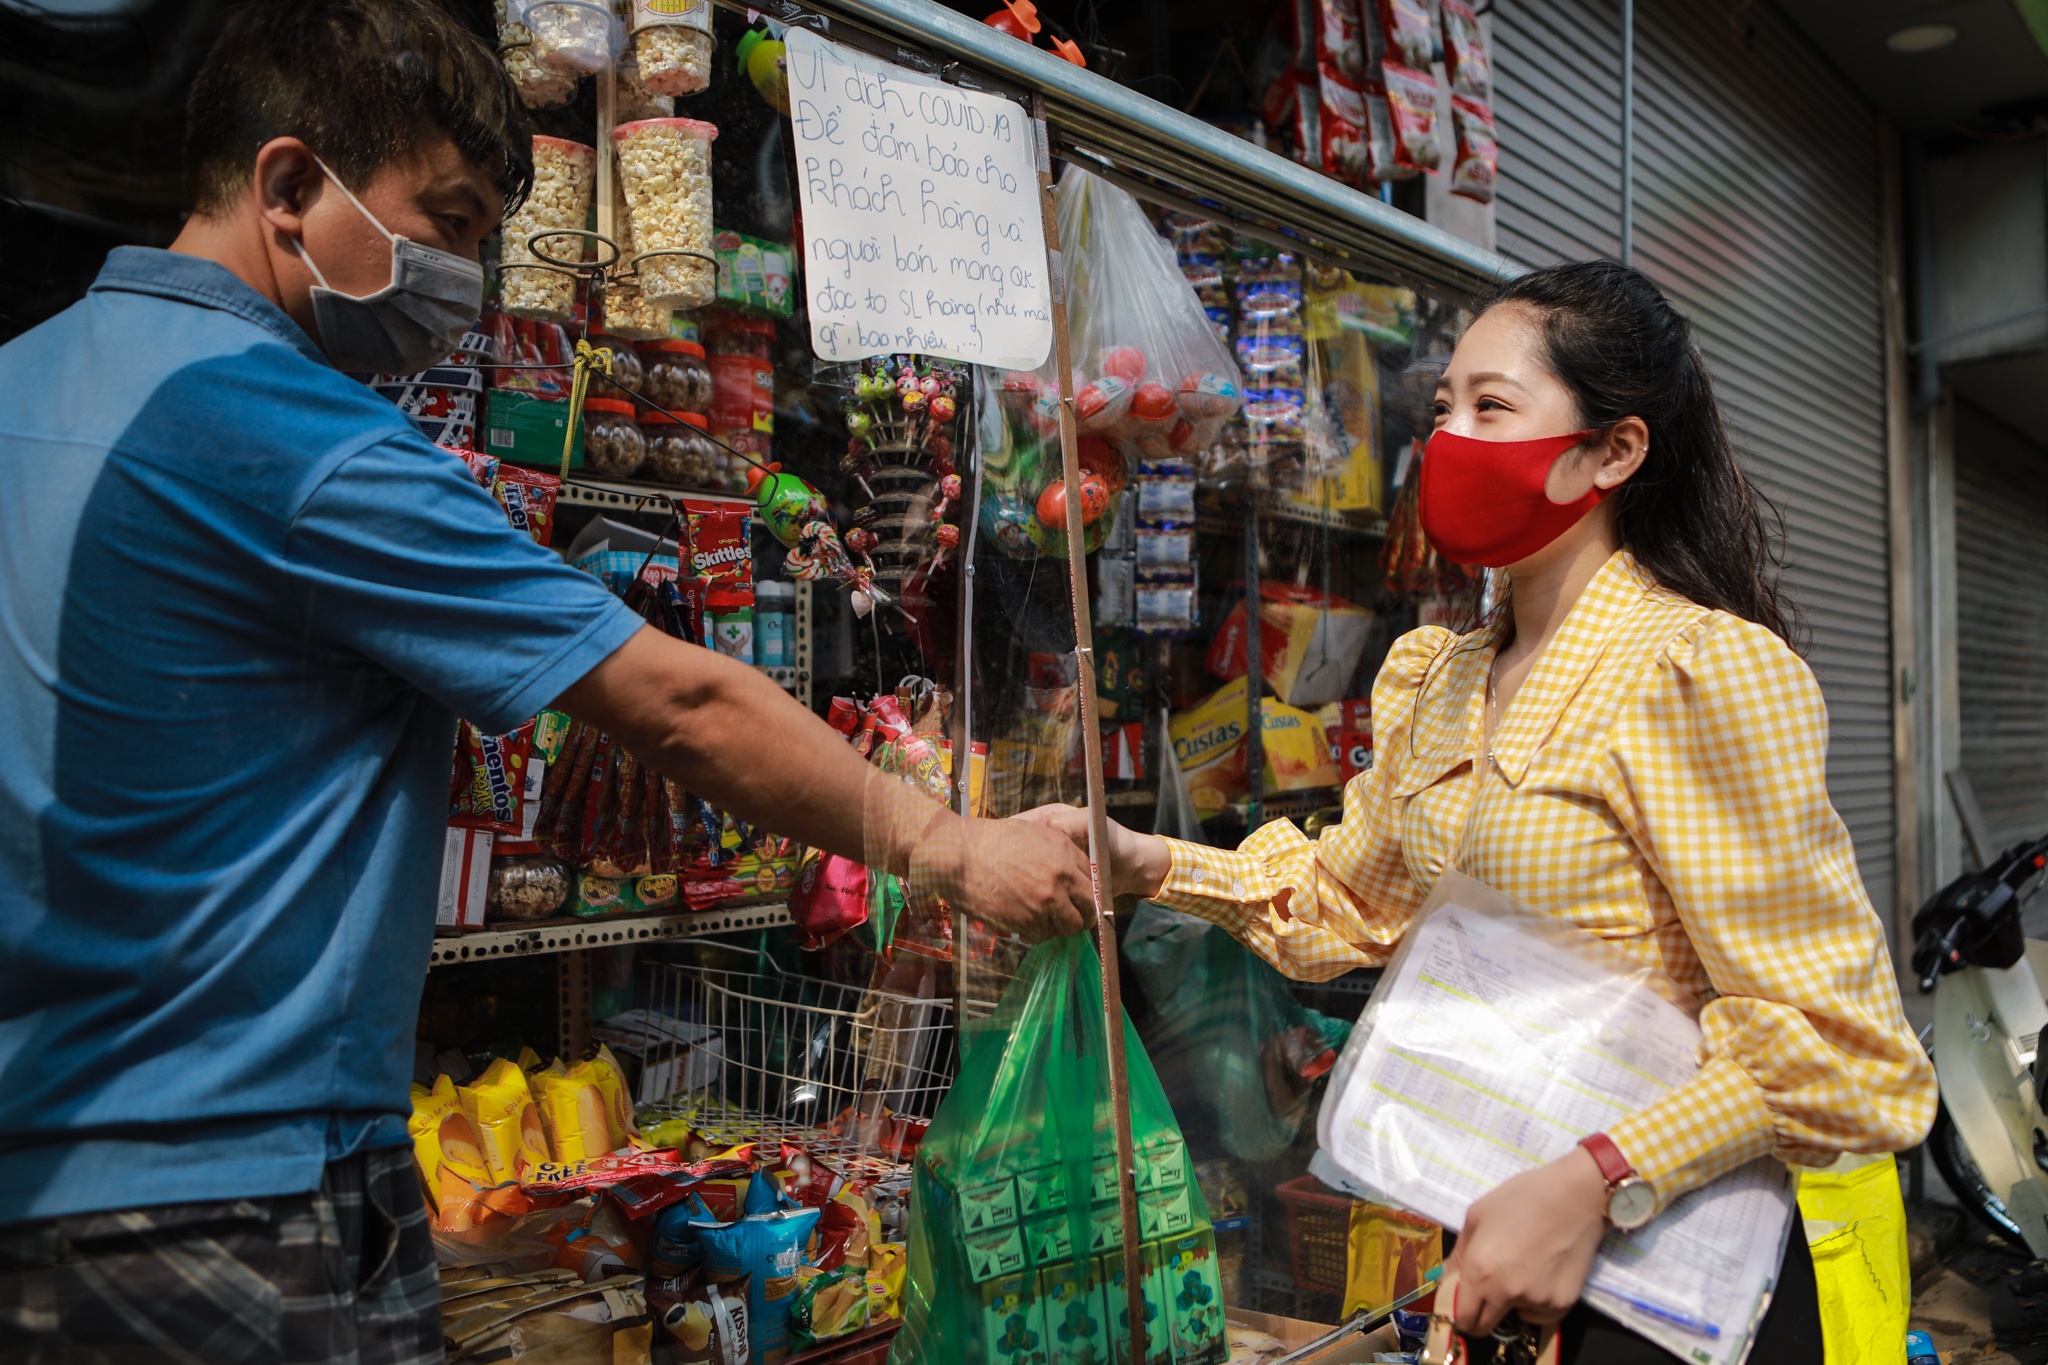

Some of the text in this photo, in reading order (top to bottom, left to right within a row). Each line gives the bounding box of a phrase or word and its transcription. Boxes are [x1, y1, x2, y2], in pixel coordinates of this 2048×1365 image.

[795, 99, 1017, 194] Để đảm bảo cho
[921, 179, 990, 256] hàng
[998, 216, 1025, 242] và
[812, 236, 881, 280] người
[893, 234, 938, 274] bán
[950, 257, 1005, 298] mong
[816, 277, 857, 319] đọc
[864, 287, 887, 314] to
[899, 289, 922, 319] SL
[856, 320, 890, 348] bao
[693, 546, 752, 571] Skittles
[1173, 719, 1242, 762] Custas
[1261, 712, 1301, 731] Custas
